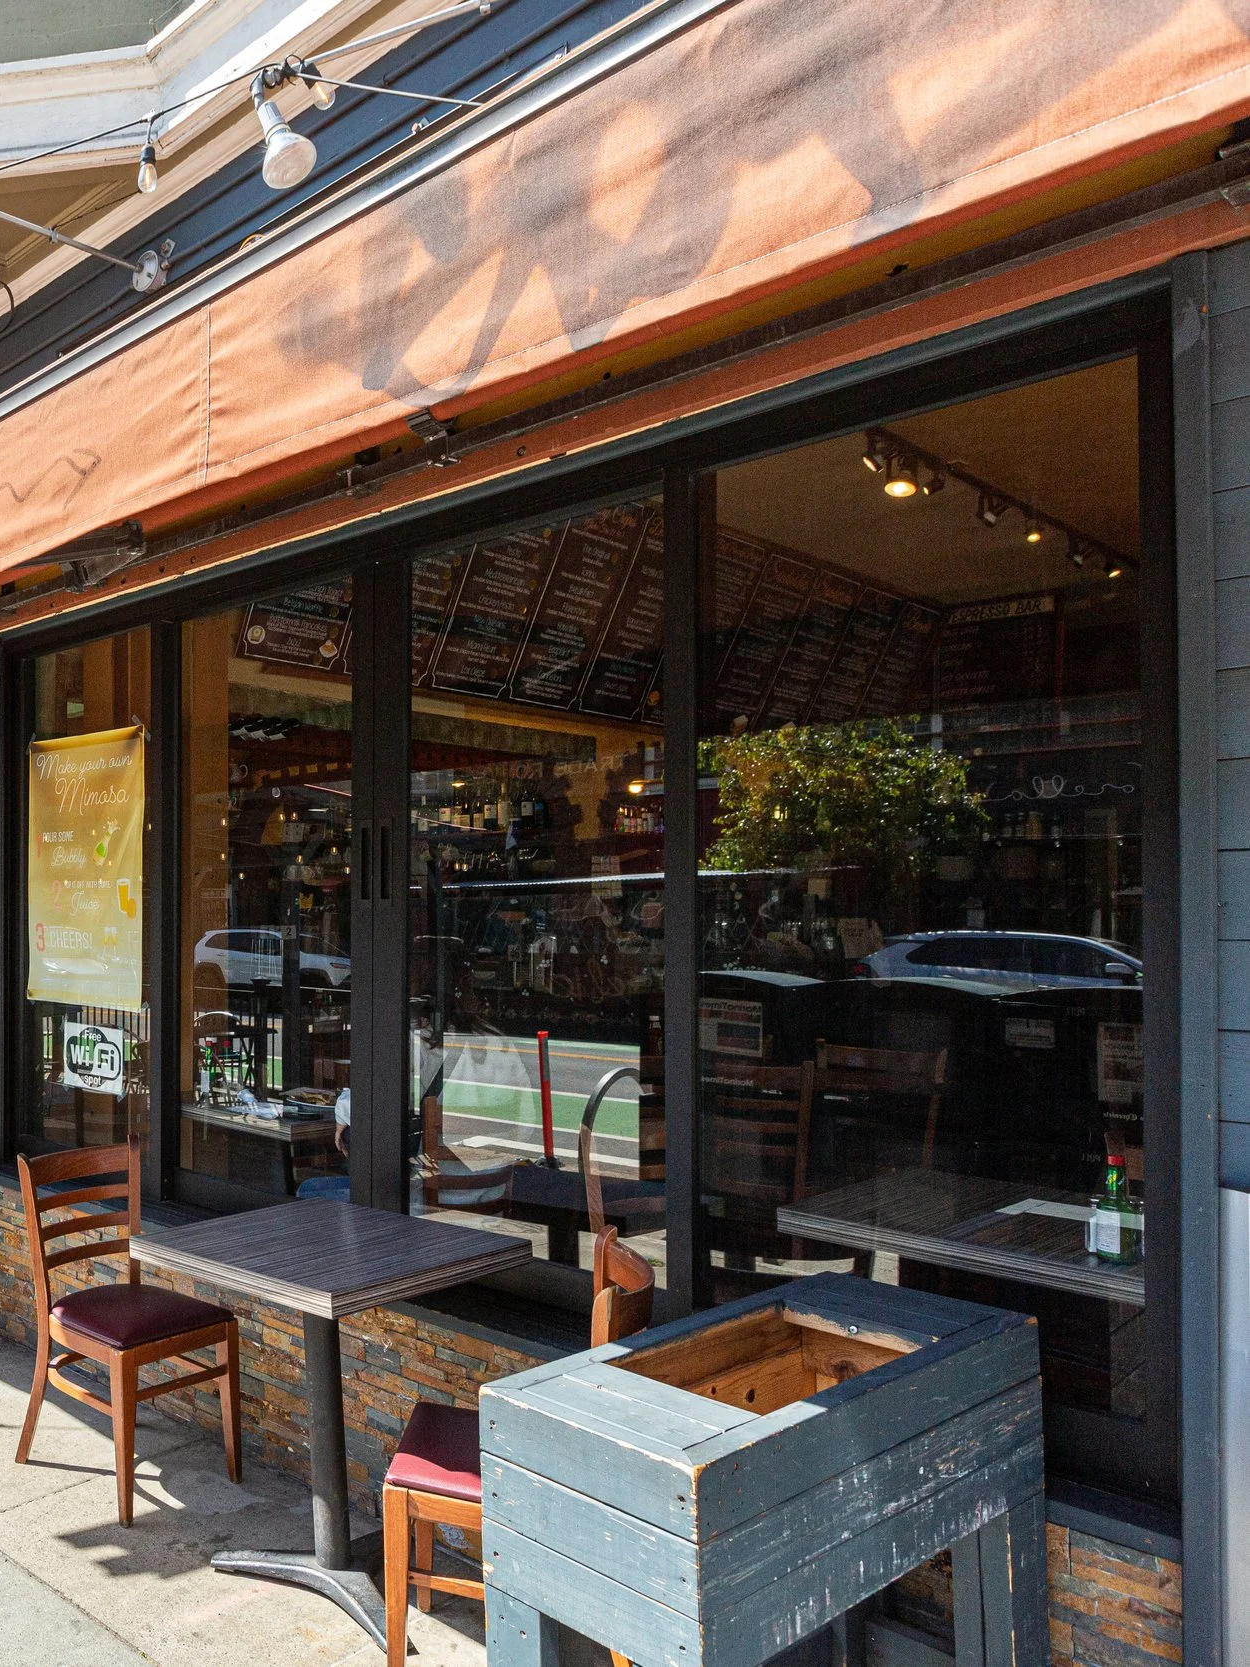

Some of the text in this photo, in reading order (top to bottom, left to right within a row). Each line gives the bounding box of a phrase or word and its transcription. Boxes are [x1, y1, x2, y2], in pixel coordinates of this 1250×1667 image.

[950, 599, 1041, 623] ESPRESSO BAR
[36, 753, 133, 780] Make your own
[55, 777, 130, 816] Mimosa
[42, 832, 57, 843] POUR
[58, 831, 74, 842] SOME
[51, 846, 87, 869] Bubbly
[70, 891, 100, 916] Juice
[35, 922, 93, 952] 3 CHEERS!
[84, 1030, 102, 1042] Free
[84, 1075, 101, 1086] spot
